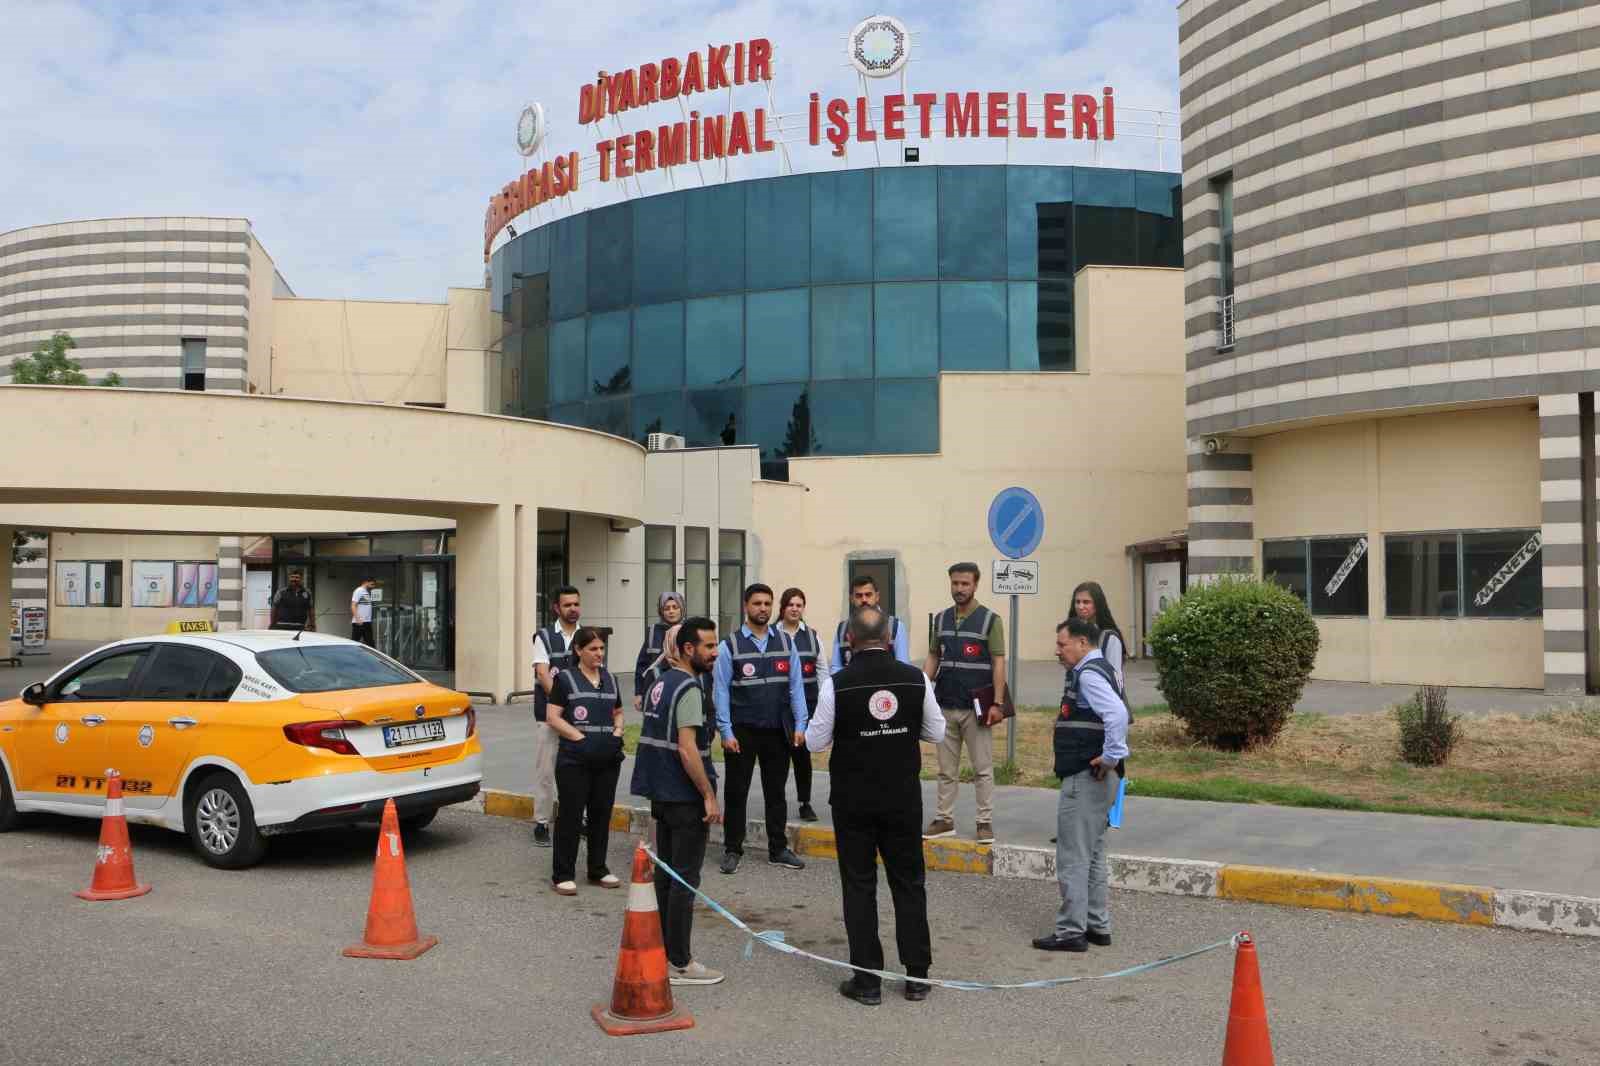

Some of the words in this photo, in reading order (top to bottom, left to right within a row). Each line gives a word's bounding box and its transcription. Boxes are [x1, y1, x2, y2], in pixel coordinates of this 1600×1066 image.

[579, 38, 773, 125] DİYARBAKIR
[597, 108, 776, 182] TERMİNAL
[809, 86, 1115, 157] İŞLETMELERİ
[390, 728, 402, 741] 21
[405, 725, 417, 738] TT
[422, 721, 443, 736] 1132
[56, 775, 76, 788] 21
[82, 776, 106, 790] TT
[118, 779, 153, 793] 132
